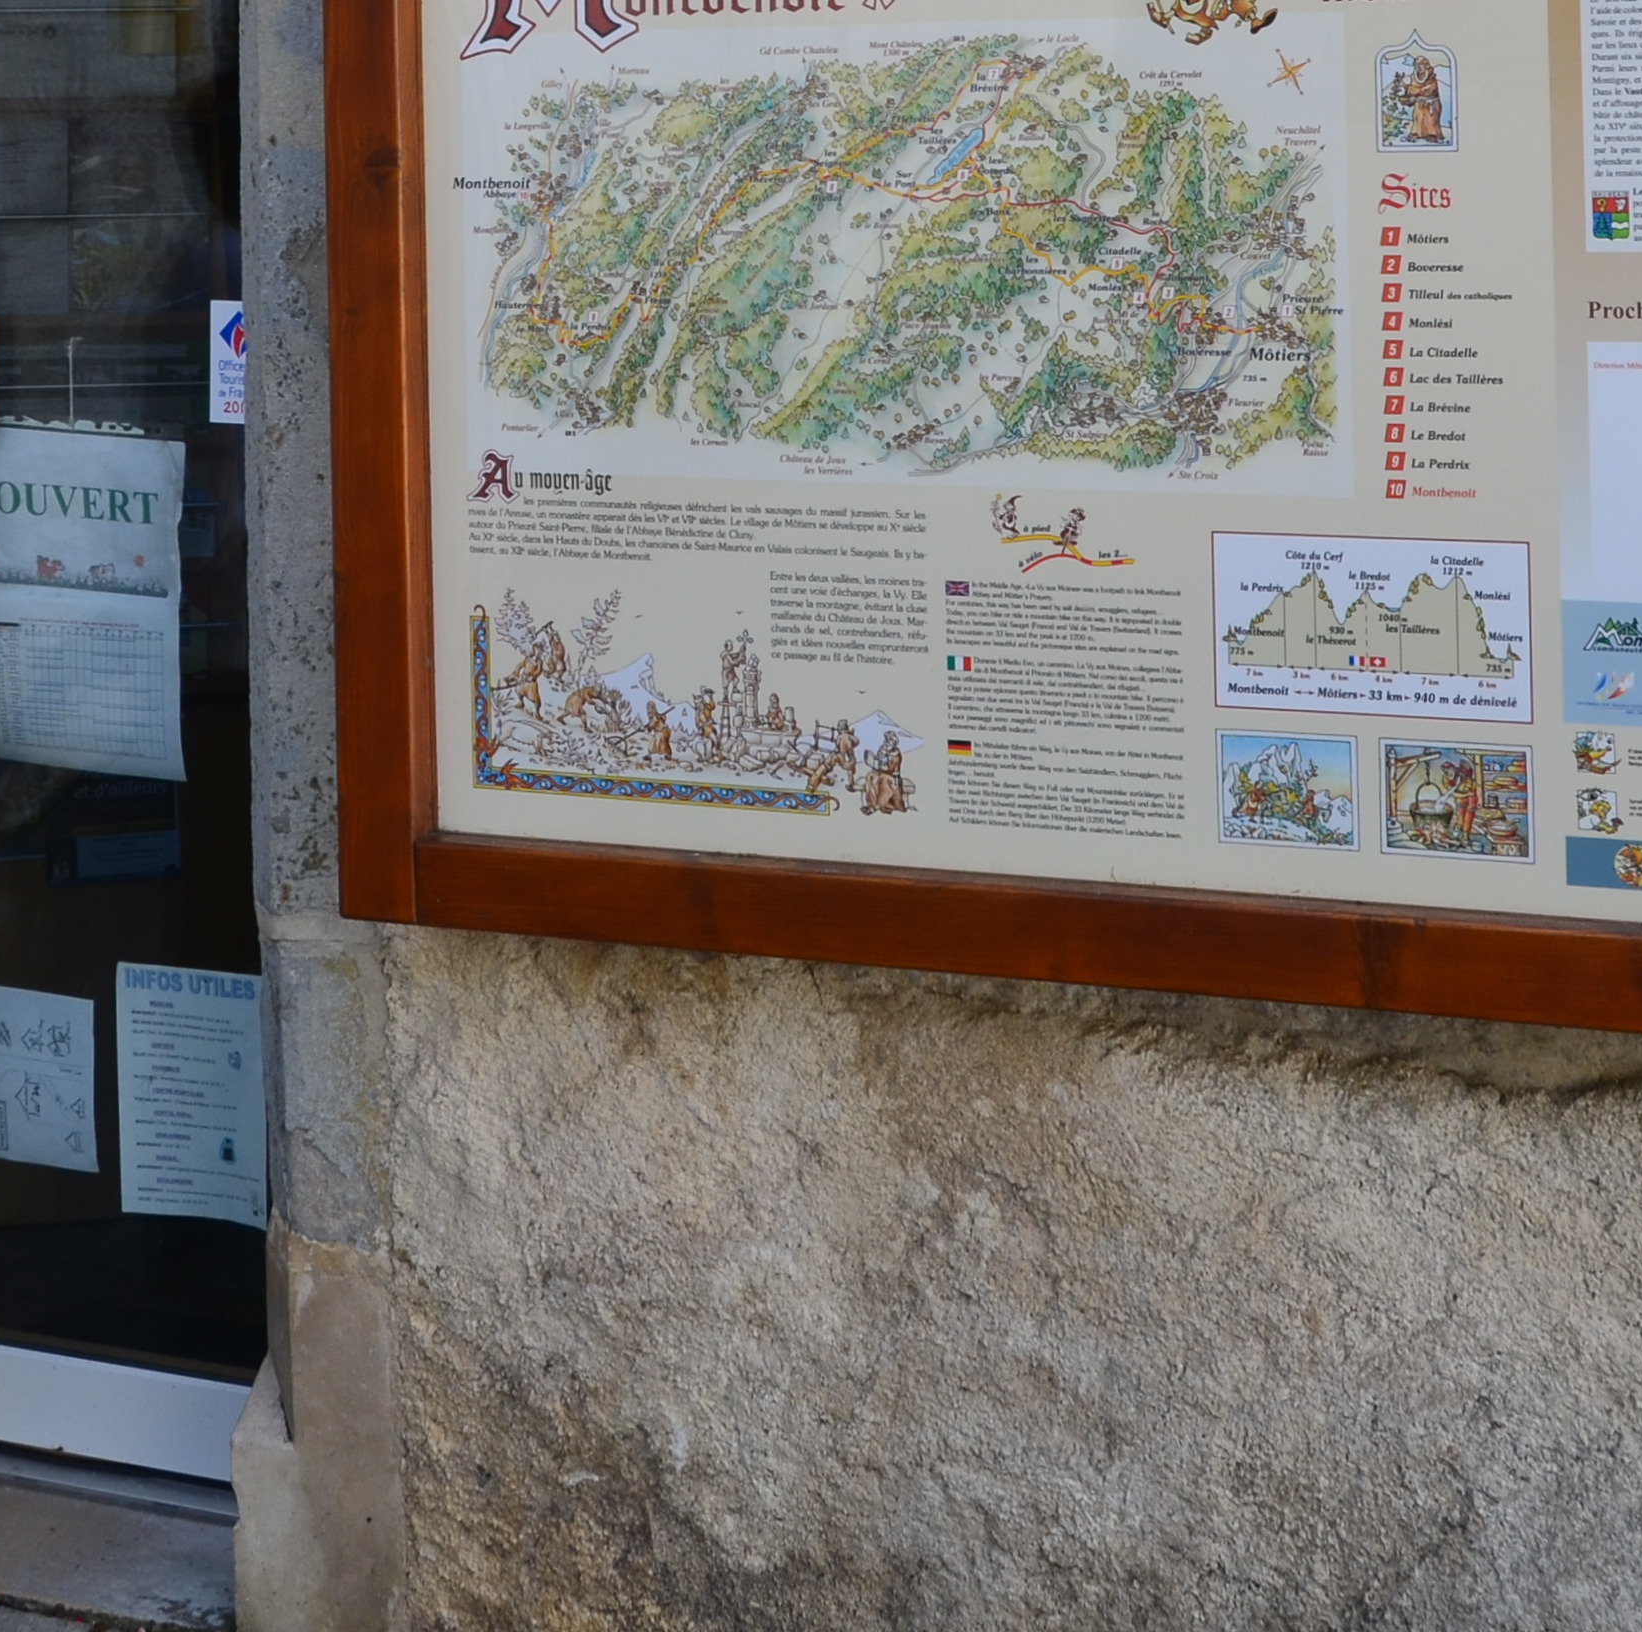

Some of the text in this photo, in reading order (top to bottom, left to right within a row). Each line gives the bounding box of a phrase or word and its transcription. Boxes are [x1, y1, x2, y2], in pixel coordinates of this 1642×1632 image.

[453, 177, 530, 190] Montbenoit
[1378, 173, 1451, 214] Sites
[1407, 234, 1448, 243] Môtiers
[1098, 247, 1142, 256] Citadelle
[1408, 262, 1463, 272] Boveresse
[1409, 289, 1443, 299] Tilleul
[1464, 293, 1512, 301] catholiques
[1249, 347, 1311, 362] Môtiers
[1410, 347, 1423, 357] La
[1427, 347, 1478, 357] Citadelle
[218, 360, 245, 371] Office
[219, 373, 245, 384] Touris
[1410, 373, 1429, 383] Lac
[1433, 374, 1451, 383] des
[1456, 374, 1503, 384] Taillères
[229, 387, 245, 397] Fra
[224, 402, 245, 413] 201
[1410, 402, 1423, 412] La
[1411, 430, 1424, 440] Le
[1428, 431, 1465, 441] Bredot
[1412, 458, 1424, 468] La
[1429, 459, 1469, 469] Perdrix
[530, 469, 611, 495] moyen-âge
[1389, 484, 1476, 498] 10 Montbenoit
[1285, 550, 1343, 563] Côte du Cerf
[1431, 556, 1484, 566] la Citadelle
[1301, 562, 1321, 572] 1210
[1443, 567, 1464, 577] 1212
[1349, 571, 1390, 581] le Bredot
[1241, 582, 1283, 592] la Perdrix
[1379, 614, 1401, 622] 1040
[1234, 626, 1284, 637] Montbenoit
[1329, 626, 1345, 634] 930
[1386, 624, 1398, 633] les
[1306, 635, 1314, 644] le
[1488, 632, 1523, 642] Môtiers
[1230, 647, 1245, 655] 775
[1228, 683, 1288, 695] Montbenoit
[1318, 687, 1357, 699] Môtiers
[1369, 690, 1382, 700] 33
[1387, 691, 1402, 701] km
[1414, 692, 1435, 703] 940
[1453, 695, 1466, 705] de
[125, 968, 255, 1001] INFOS UTILES
